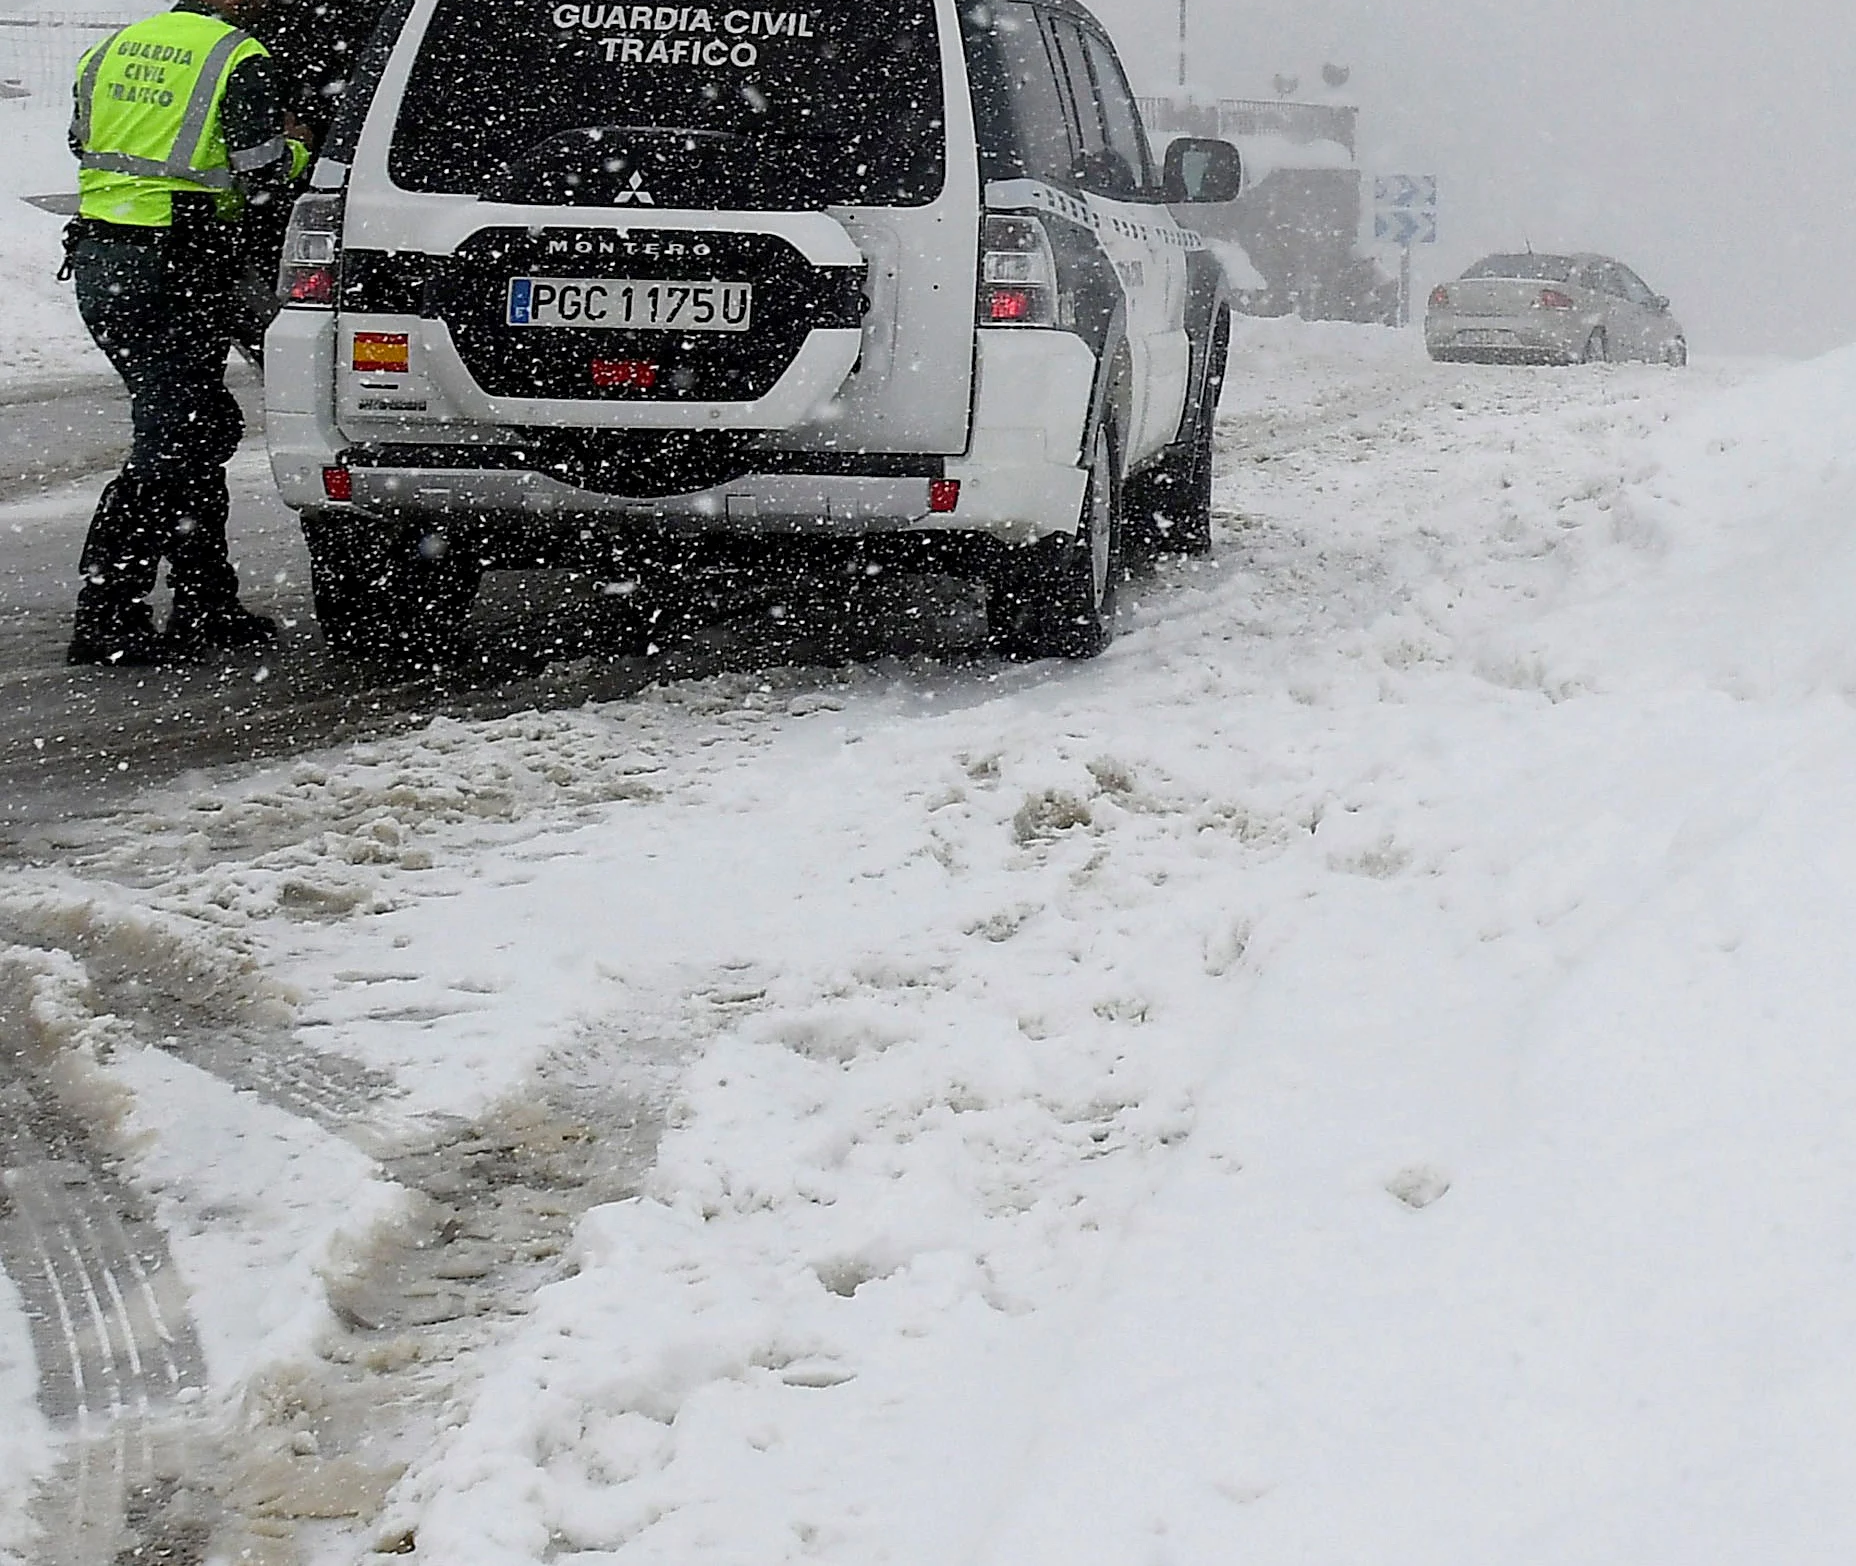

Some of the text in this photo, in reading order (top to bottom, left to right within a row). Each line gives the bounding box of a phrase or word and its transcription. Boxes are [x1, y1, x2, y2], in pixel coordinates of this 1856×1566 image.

[552, 3, 814, 38] GUARDIA CIVIL
[117, 41, 193, 66] GUARDIA
[124, 62, 166, 84] CIVIL
[549, 239, 711, 256] MONTERO
[531, 284, 607, 321] PGC
